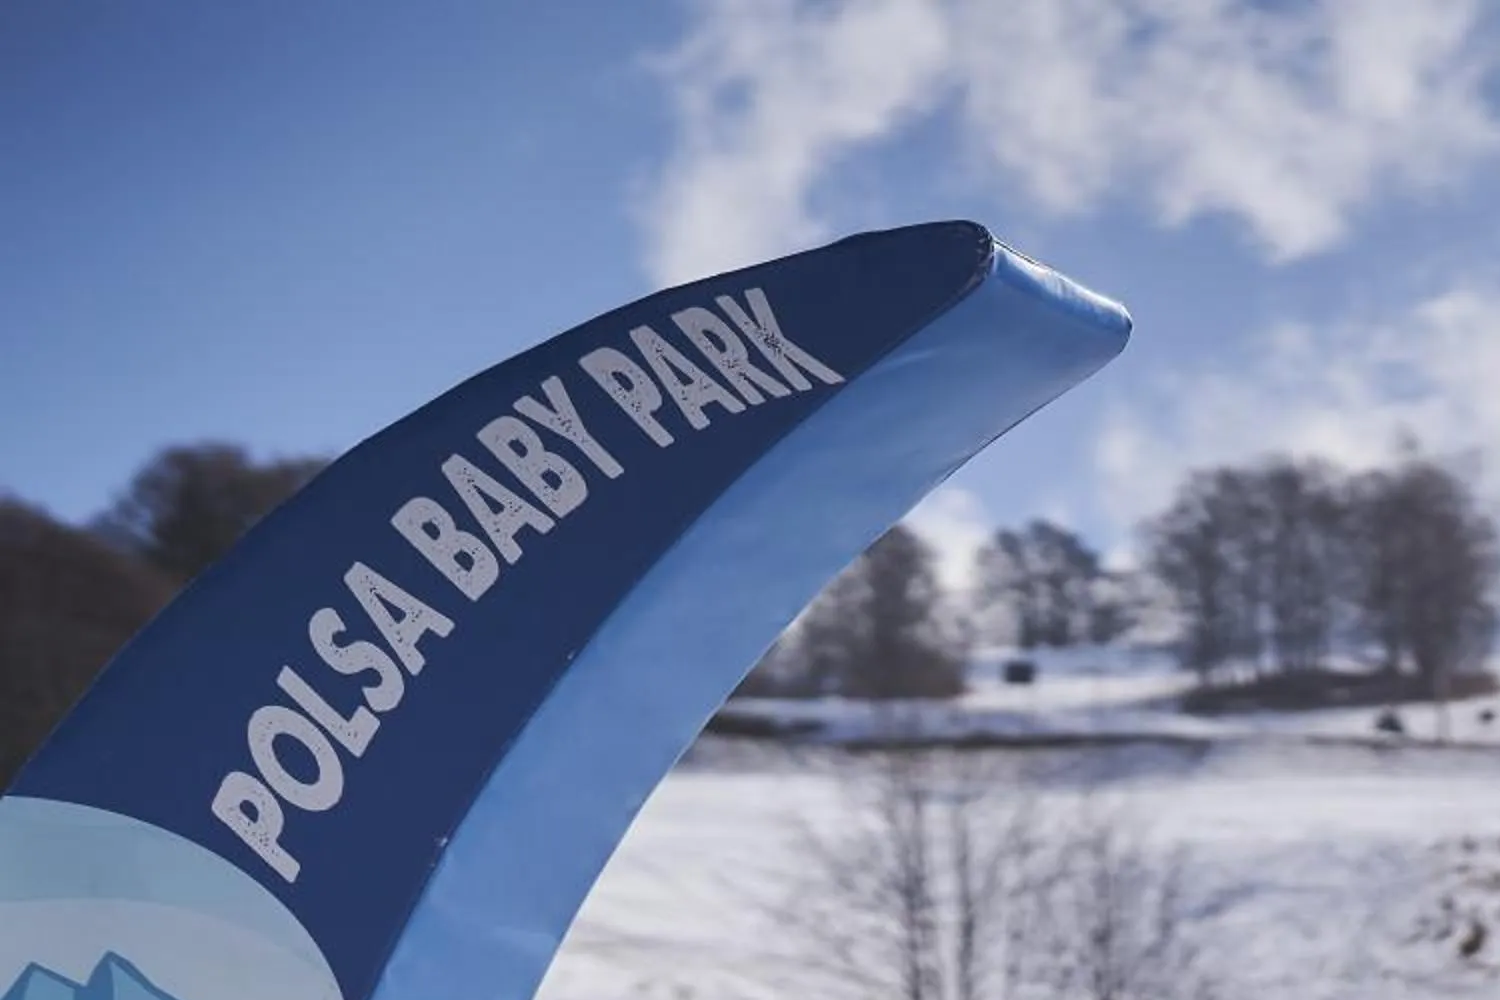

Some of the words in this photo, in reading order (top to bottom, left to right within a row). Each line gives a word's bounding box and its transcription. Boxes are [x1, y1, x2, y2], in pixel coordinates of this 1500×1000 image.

[211, 561, 454, 882] POLSA
[391, 376, 624, 601] BABY
[579, 288, 845, 447] PARK
